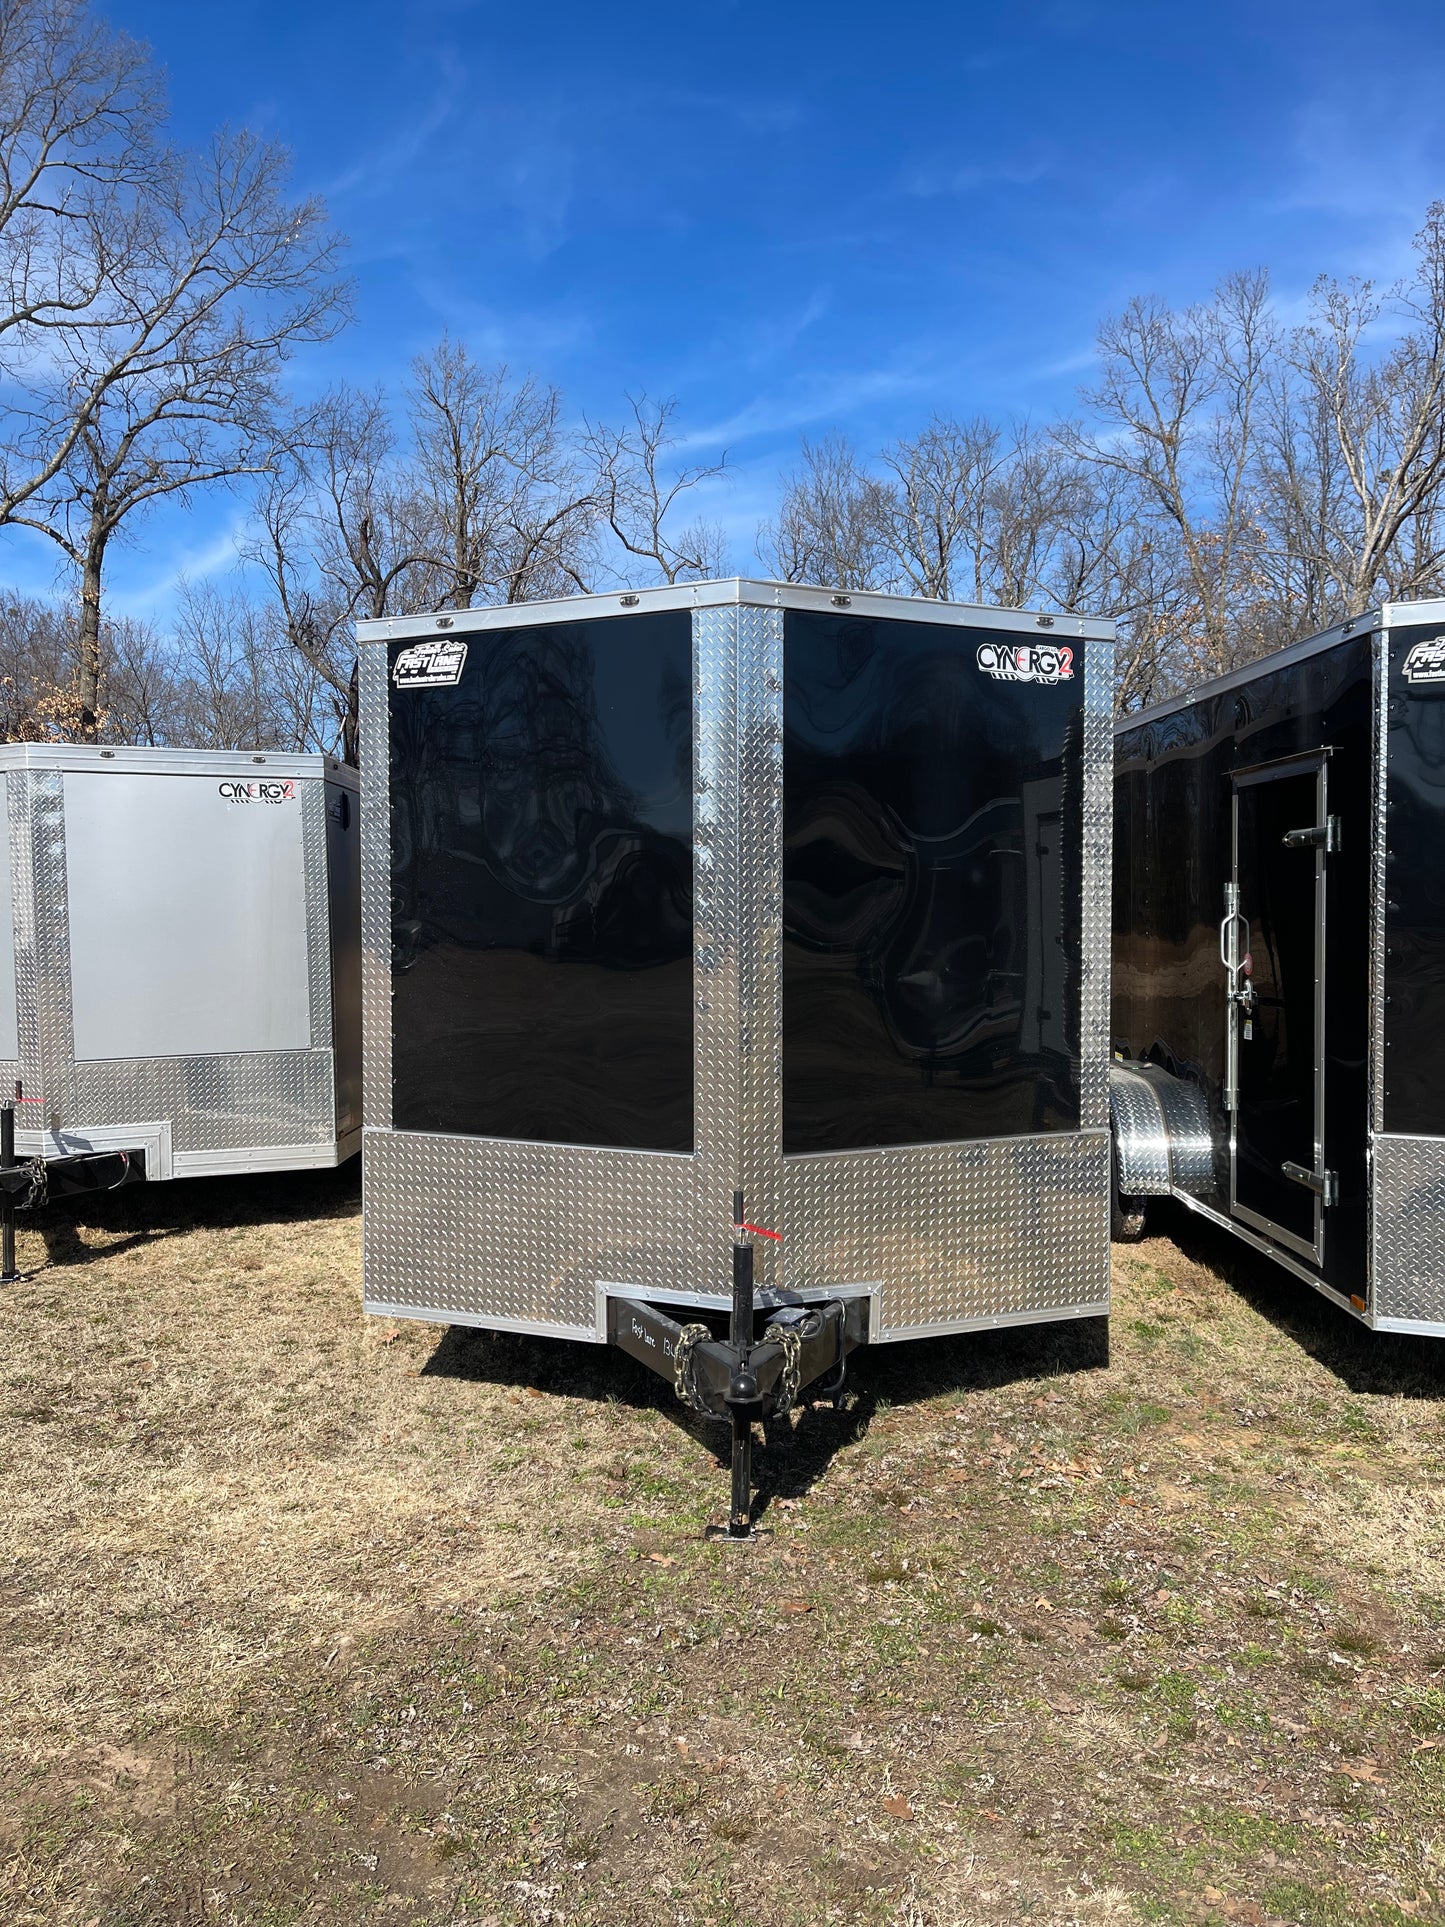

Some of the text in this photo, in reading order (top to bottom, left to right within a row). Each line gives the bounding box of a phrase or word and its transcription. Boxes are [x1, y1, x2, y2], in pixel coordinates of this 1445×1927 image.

[397, 653, 431, 669] FAST
[426, 653, 462, 673] LANE
[1409, 646, 1445, 663] FAS
